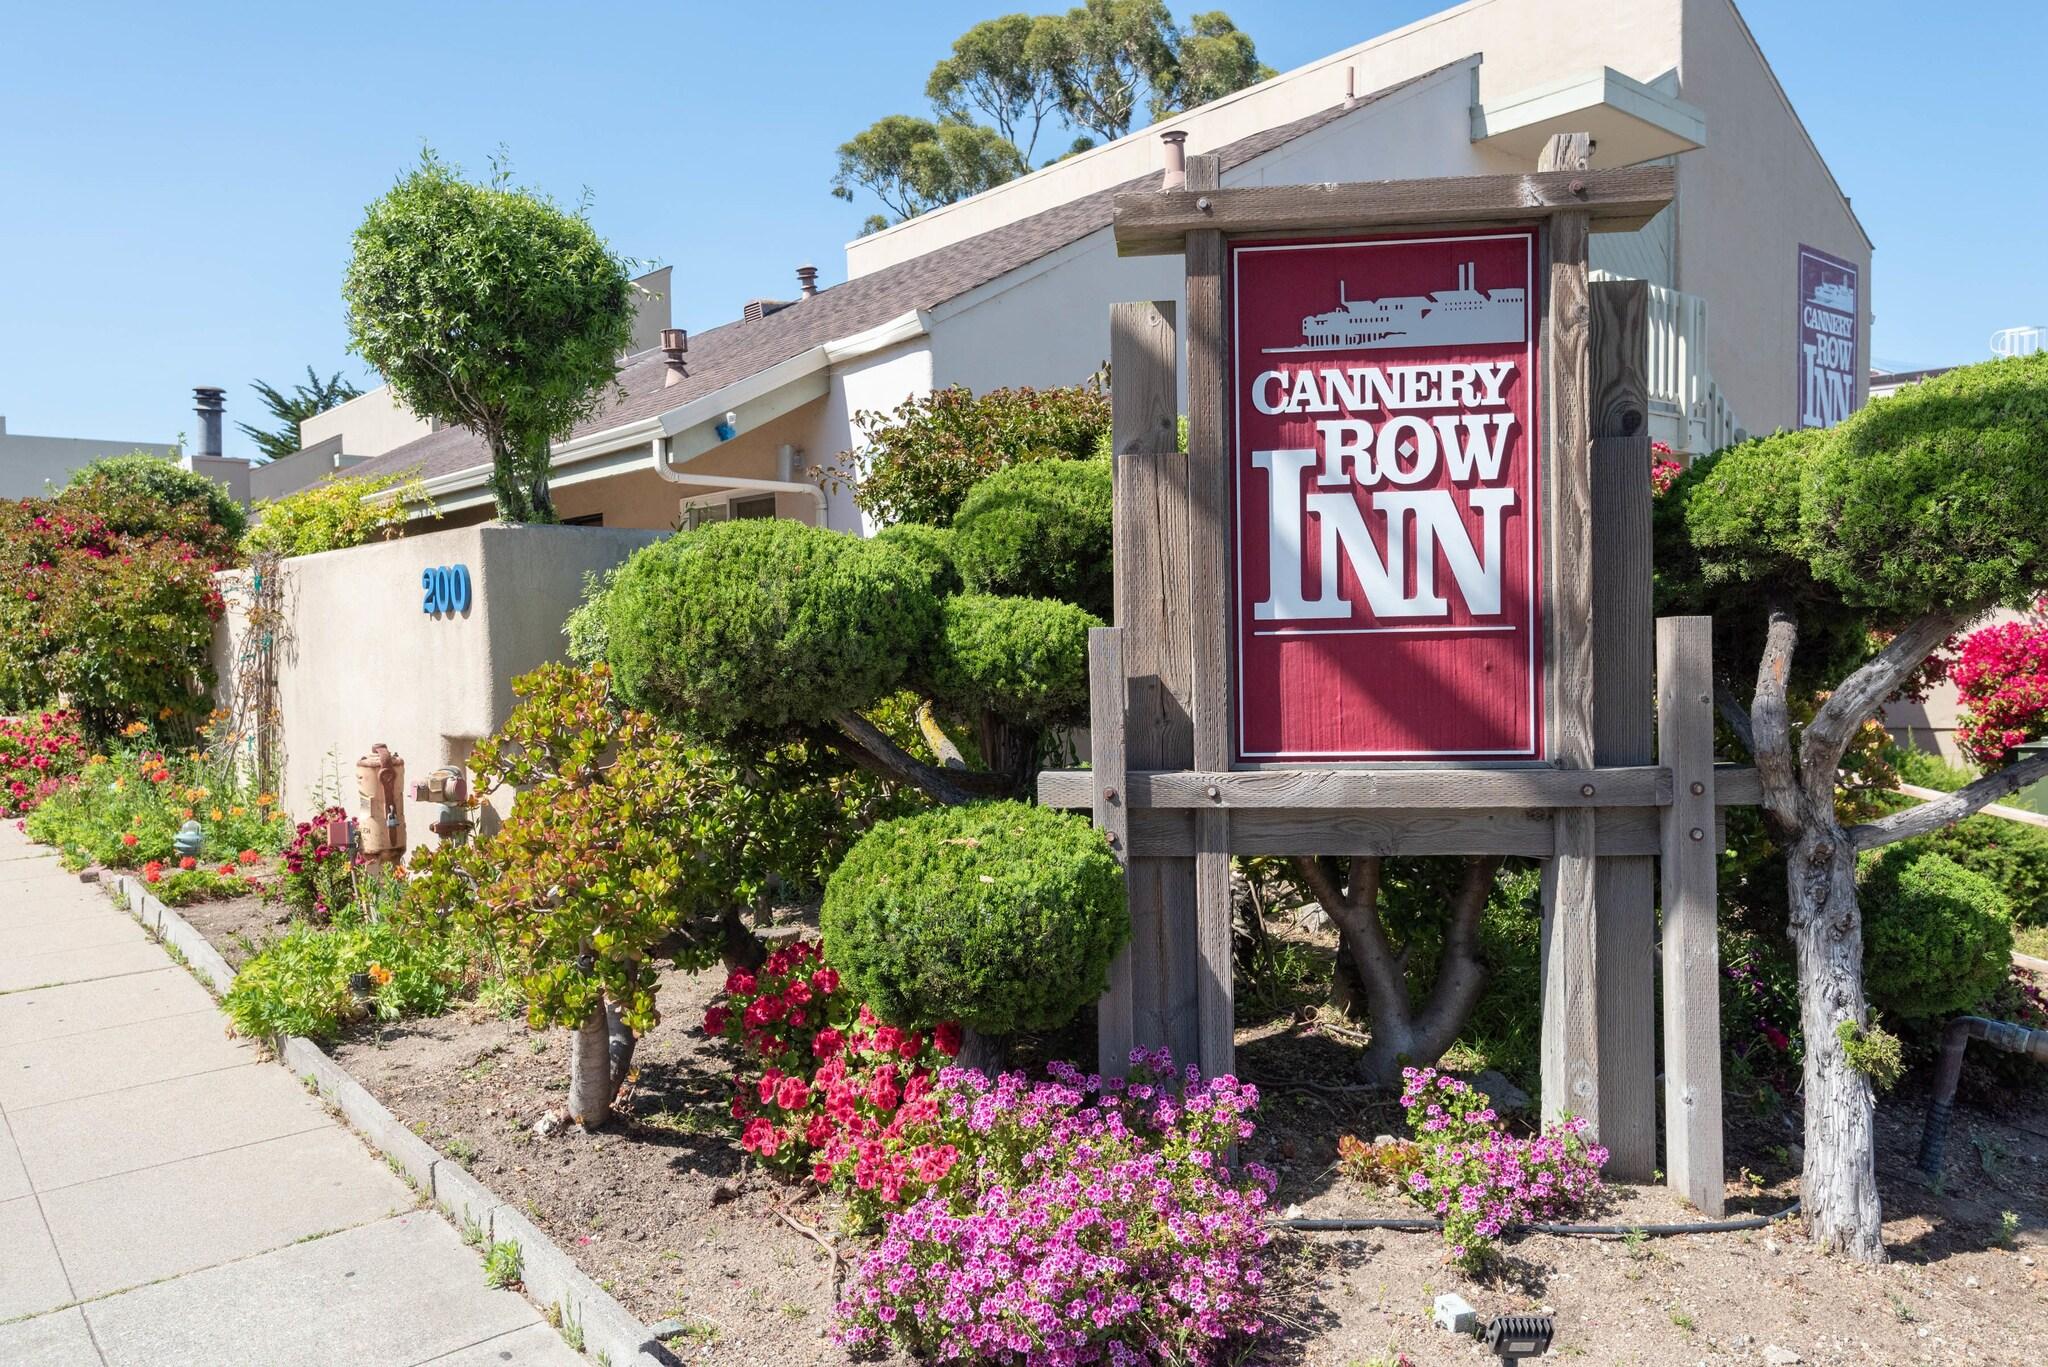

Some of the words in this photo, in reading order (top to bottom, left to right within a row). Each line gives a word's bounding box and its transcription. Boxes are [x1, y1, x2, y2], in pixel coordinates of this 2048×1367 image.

[1804, 306, 1853, 337] CANNERY
[1816, 333, 1853, 371] ROW
[1252, 361, 1515, 415] CANNERY
[1803, 343, 1852, 428] INN
[1316, 415, 1515, 486] ROW
[1252, 449, 1514, 620] INN
[422, 564, 472, 614] 200
